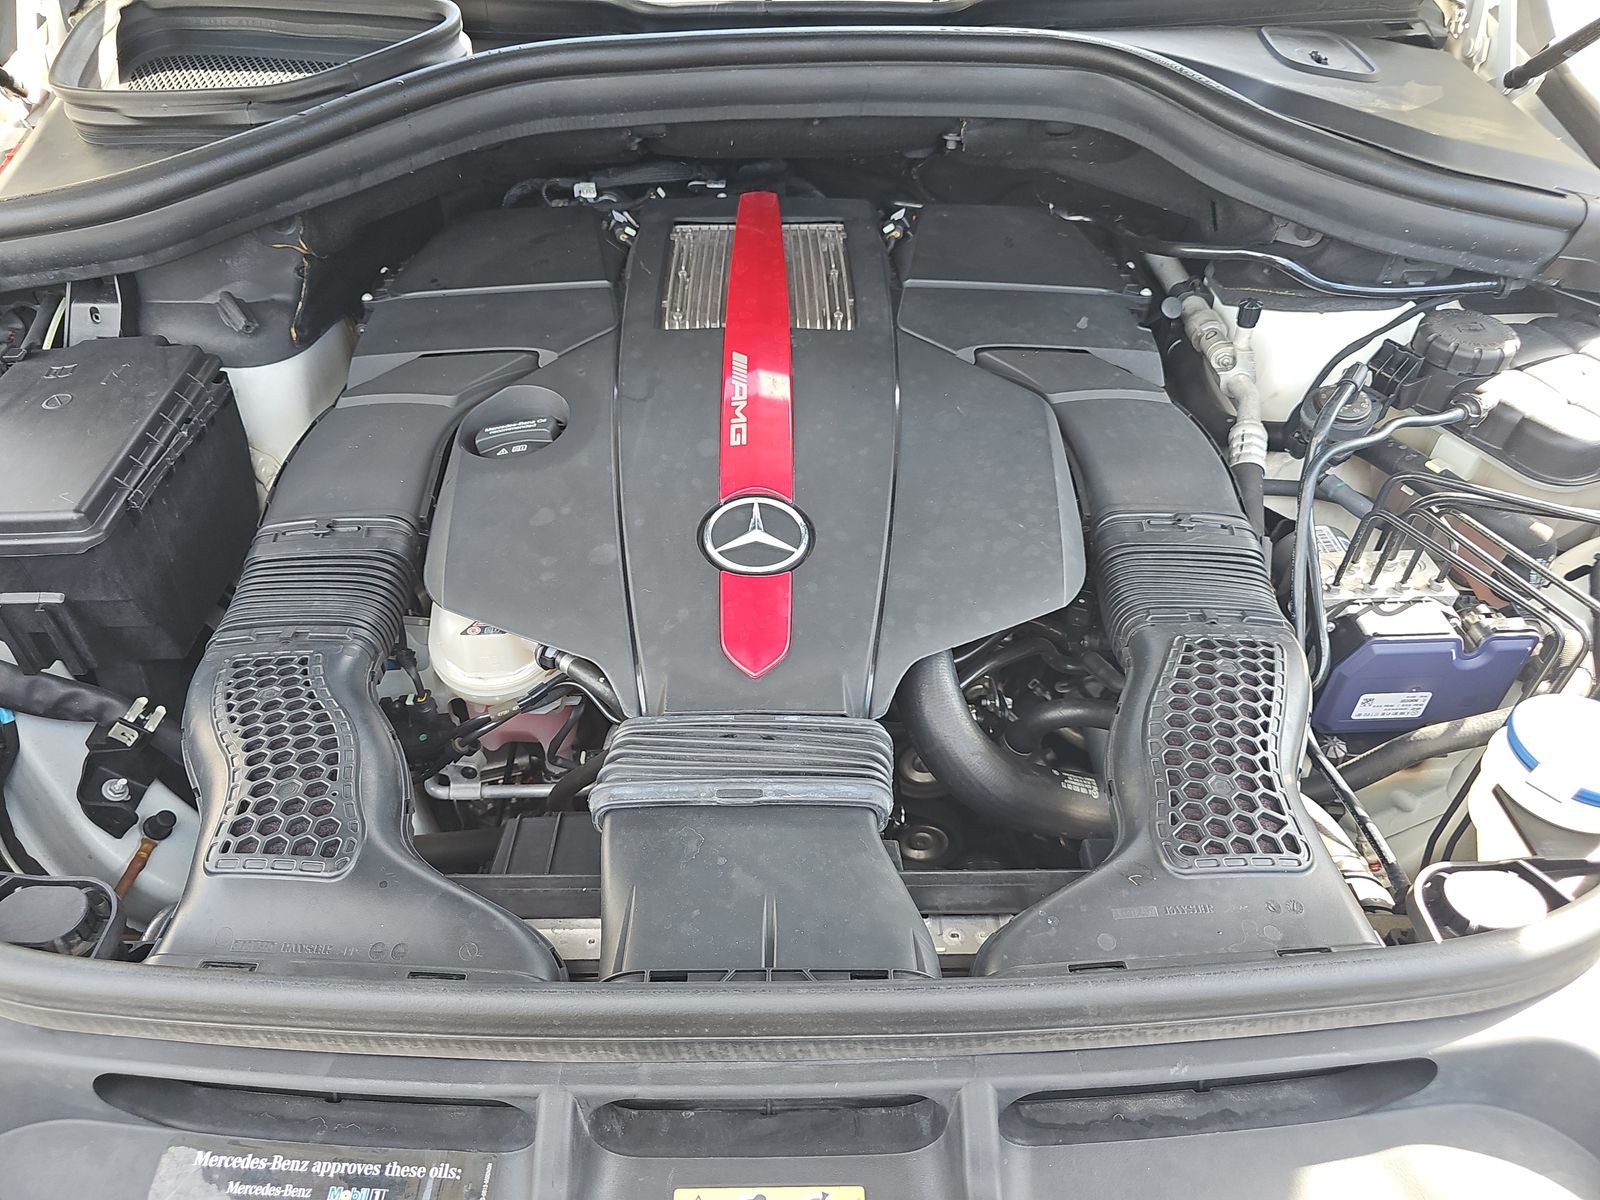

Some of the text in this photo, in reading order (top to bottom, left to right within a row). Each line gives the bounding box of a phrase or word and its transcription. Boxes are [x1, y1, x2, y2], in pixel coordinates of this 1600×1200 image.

[729, 379, 748, 446] AMG
[192, 1150, 463, 1180] Mercedes-Benz approves these oils:
[225, 1180, 313, 1198] Mercedes-Benz
[327, 1185, 370, 1200] Mobil
